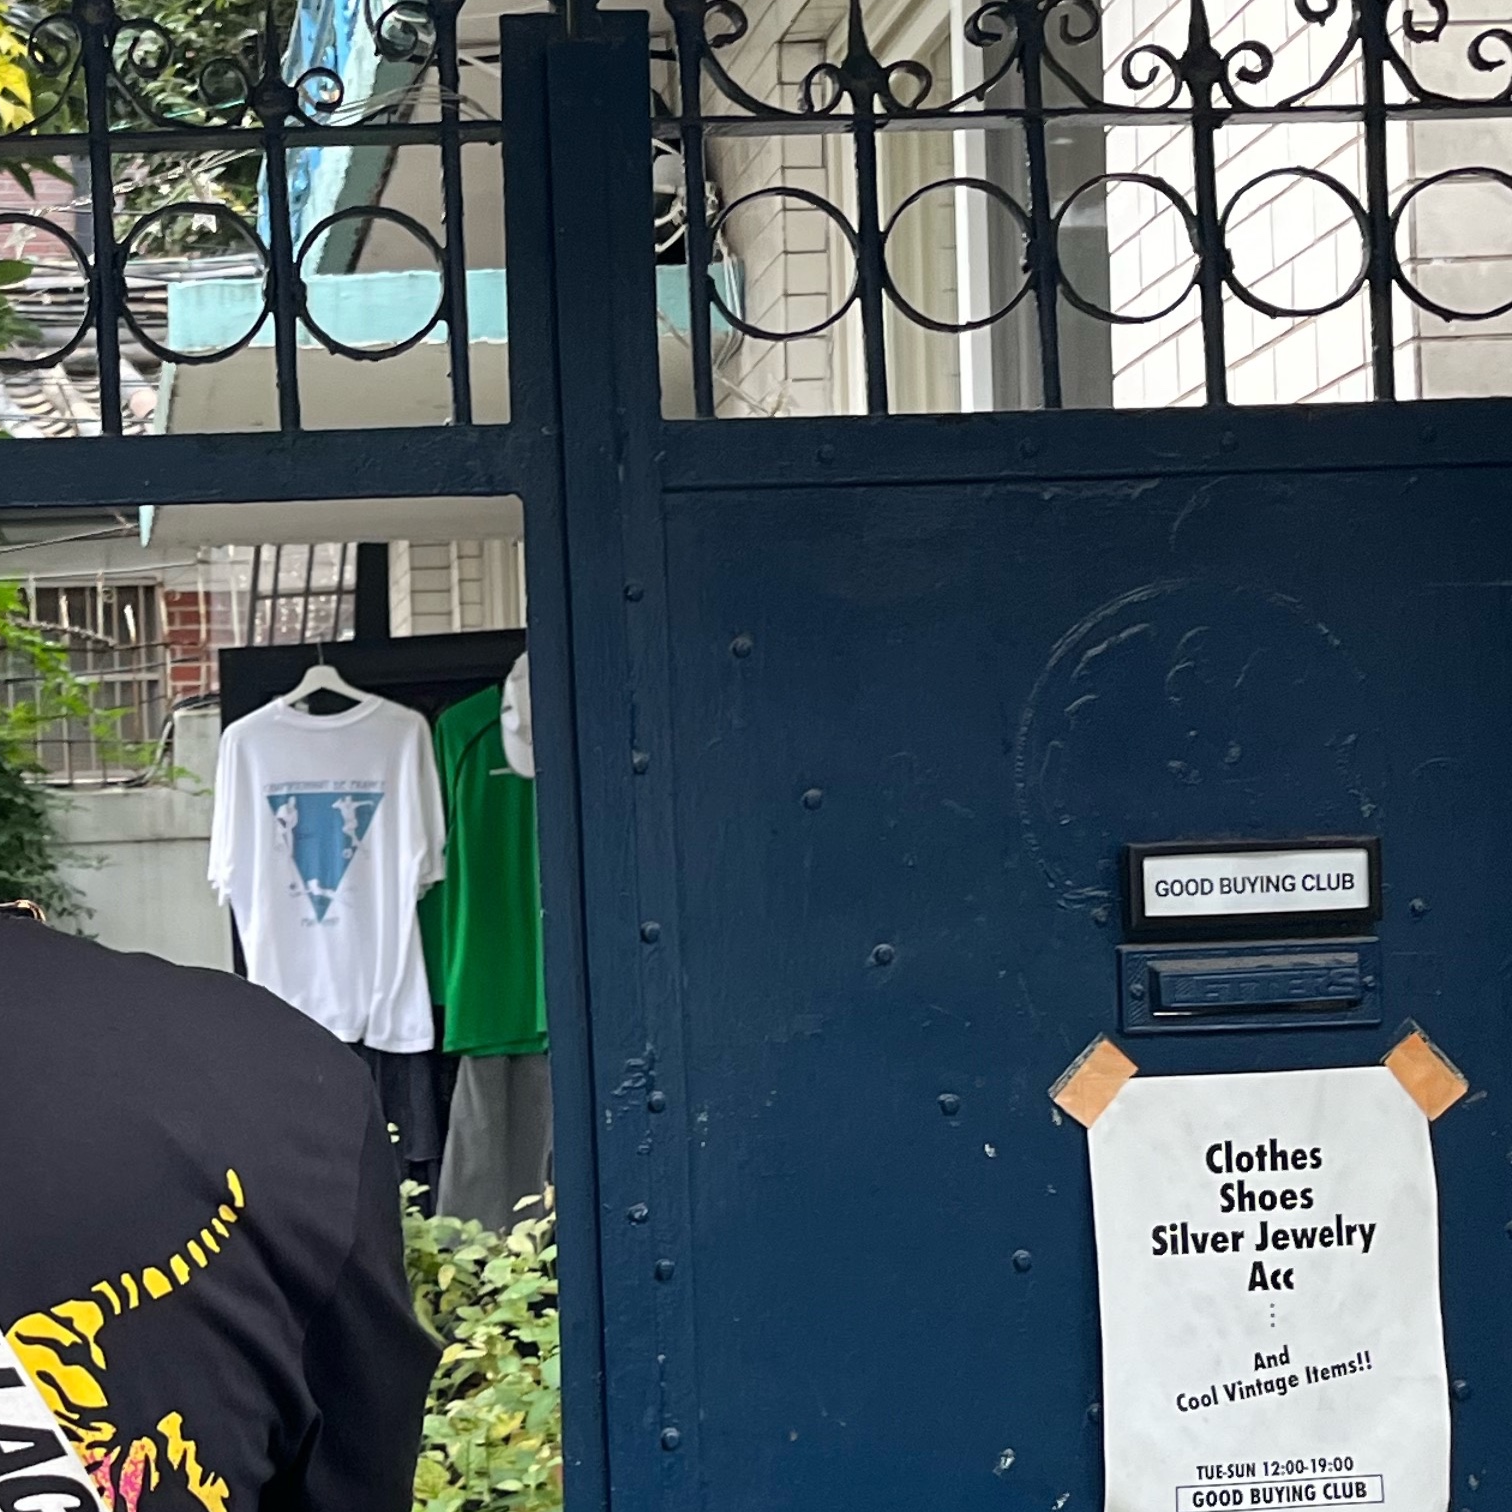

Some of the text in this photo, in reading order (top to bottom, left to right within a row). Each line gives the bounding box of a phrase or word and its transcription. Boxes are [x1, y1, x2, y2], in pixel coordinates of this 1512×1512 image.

[1154, 872, 1355, 898] GOOD BUYING CLUB
[1205, 1138, 1322, 1174] Clothes
[1219, 1179, 1314, 1213] Shoes
[1151, 1213, 1377, 1256] Silver Jewelry
[1247, 1260, 1294, 1292] Acc
[1254, 1344, 1291, 1371] And
[1176, 1350, 1372, 1412] Cool Vintage Items!!
[1196, 1455, 1354, 1480] TUE-SUN 12:00-19:00
[1192, 1480, 1368, 1508] GOOD BUYING CLUB
